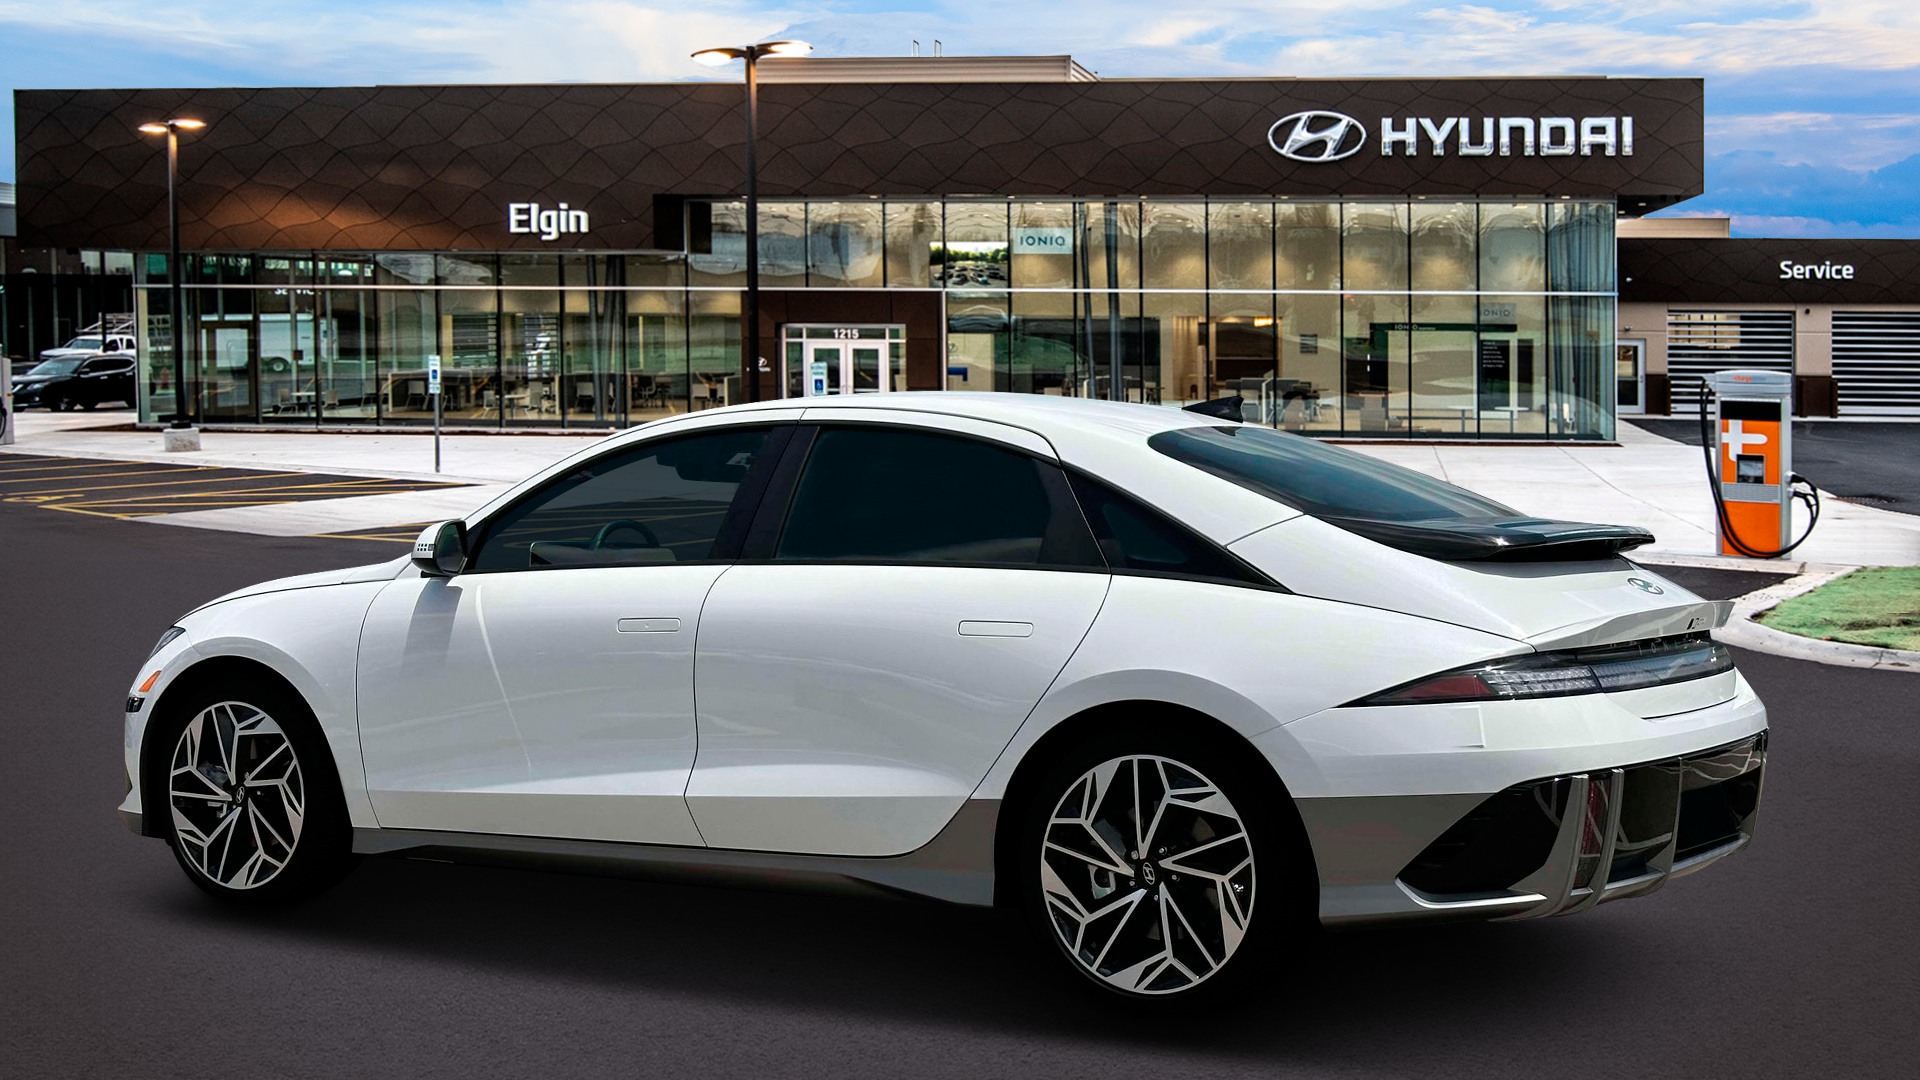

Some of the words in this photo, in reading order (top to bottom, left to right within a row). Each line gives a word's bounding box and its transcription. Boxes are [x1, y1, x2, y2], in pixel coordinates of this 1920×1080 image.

[1381, 116, 1634, 156] HYUNDAI
[509, 203, 590, 240] Elgin
[1020, 235, 1066, 247] IONIQ
[1779, 260, 1855, 280] Service
[832, 328, 860, 339] 1215
